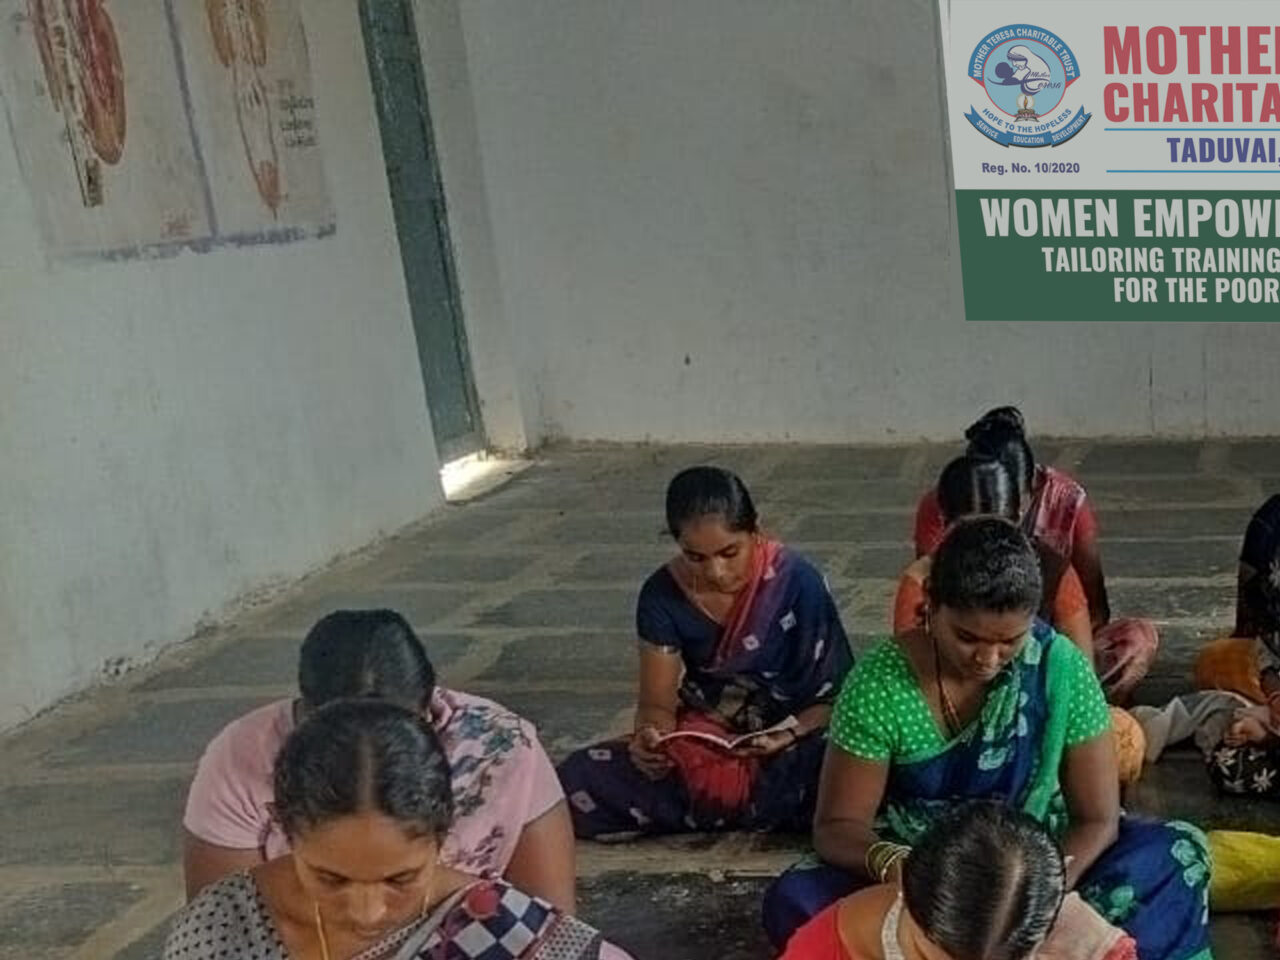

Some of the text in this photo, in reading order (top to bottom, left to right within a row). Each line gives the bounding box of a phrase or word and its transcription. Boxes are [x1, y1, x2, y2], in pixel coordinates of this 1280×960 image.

[974, 28, 1076, 78] MOTHER TERESA CHARITABLE TRUST
[976, 120, 998, 138] SERVICE
[982, 108, 1072, 133] HOPE TO THE HOPELESS
[1052, 116, 1086, 142] DEVELOPMENT
[1013, 136, 1044, 144] EDUCATION
[982, 162, 1080, 175] Reg. No. 10/2020
[979, 198, 1119, 238] WOMEN
[1041, 247, 1165, 272] TAILORING
[1113, 277, 1158, 302] FOR
[1165, 277, 1208, 303] THE
[1215, 278, 1280, 304] POOR
